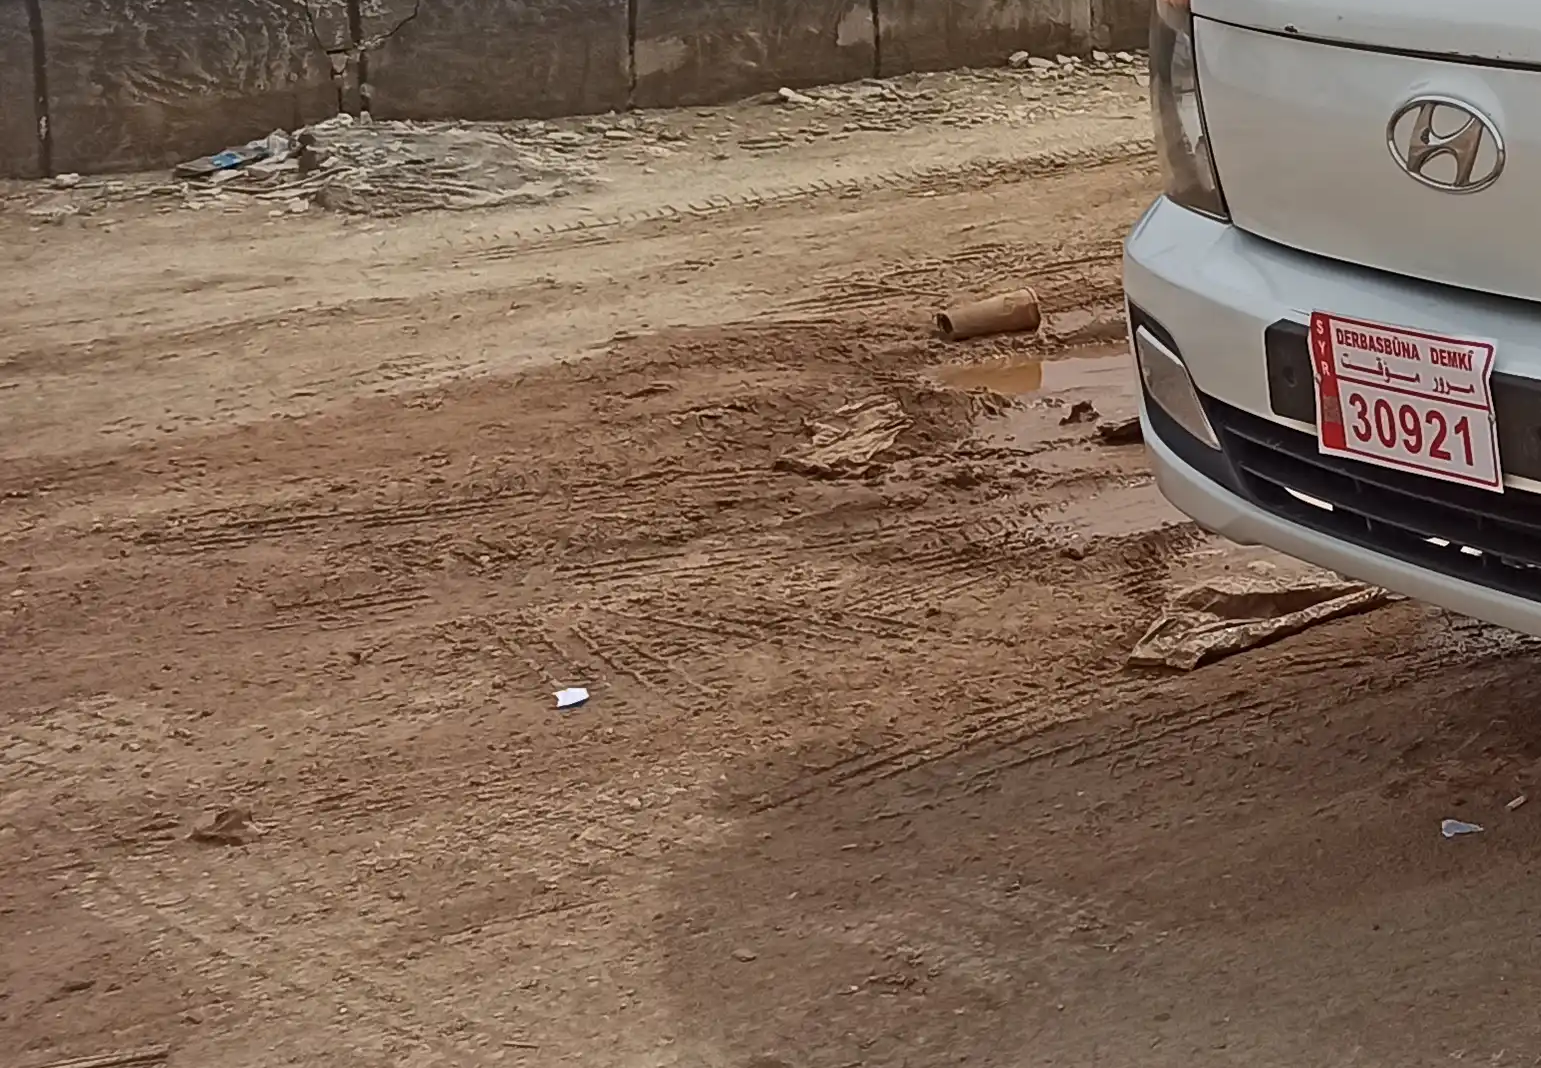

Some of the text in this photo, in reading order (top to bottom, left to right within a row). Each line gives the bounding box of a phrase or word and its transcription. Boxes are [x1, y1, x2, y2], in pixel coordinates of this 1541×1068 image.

[1336, 328, 1474, 372] DERBASBÛNA DEMKÎ
[1349, 393, 1474, 466] 30921
